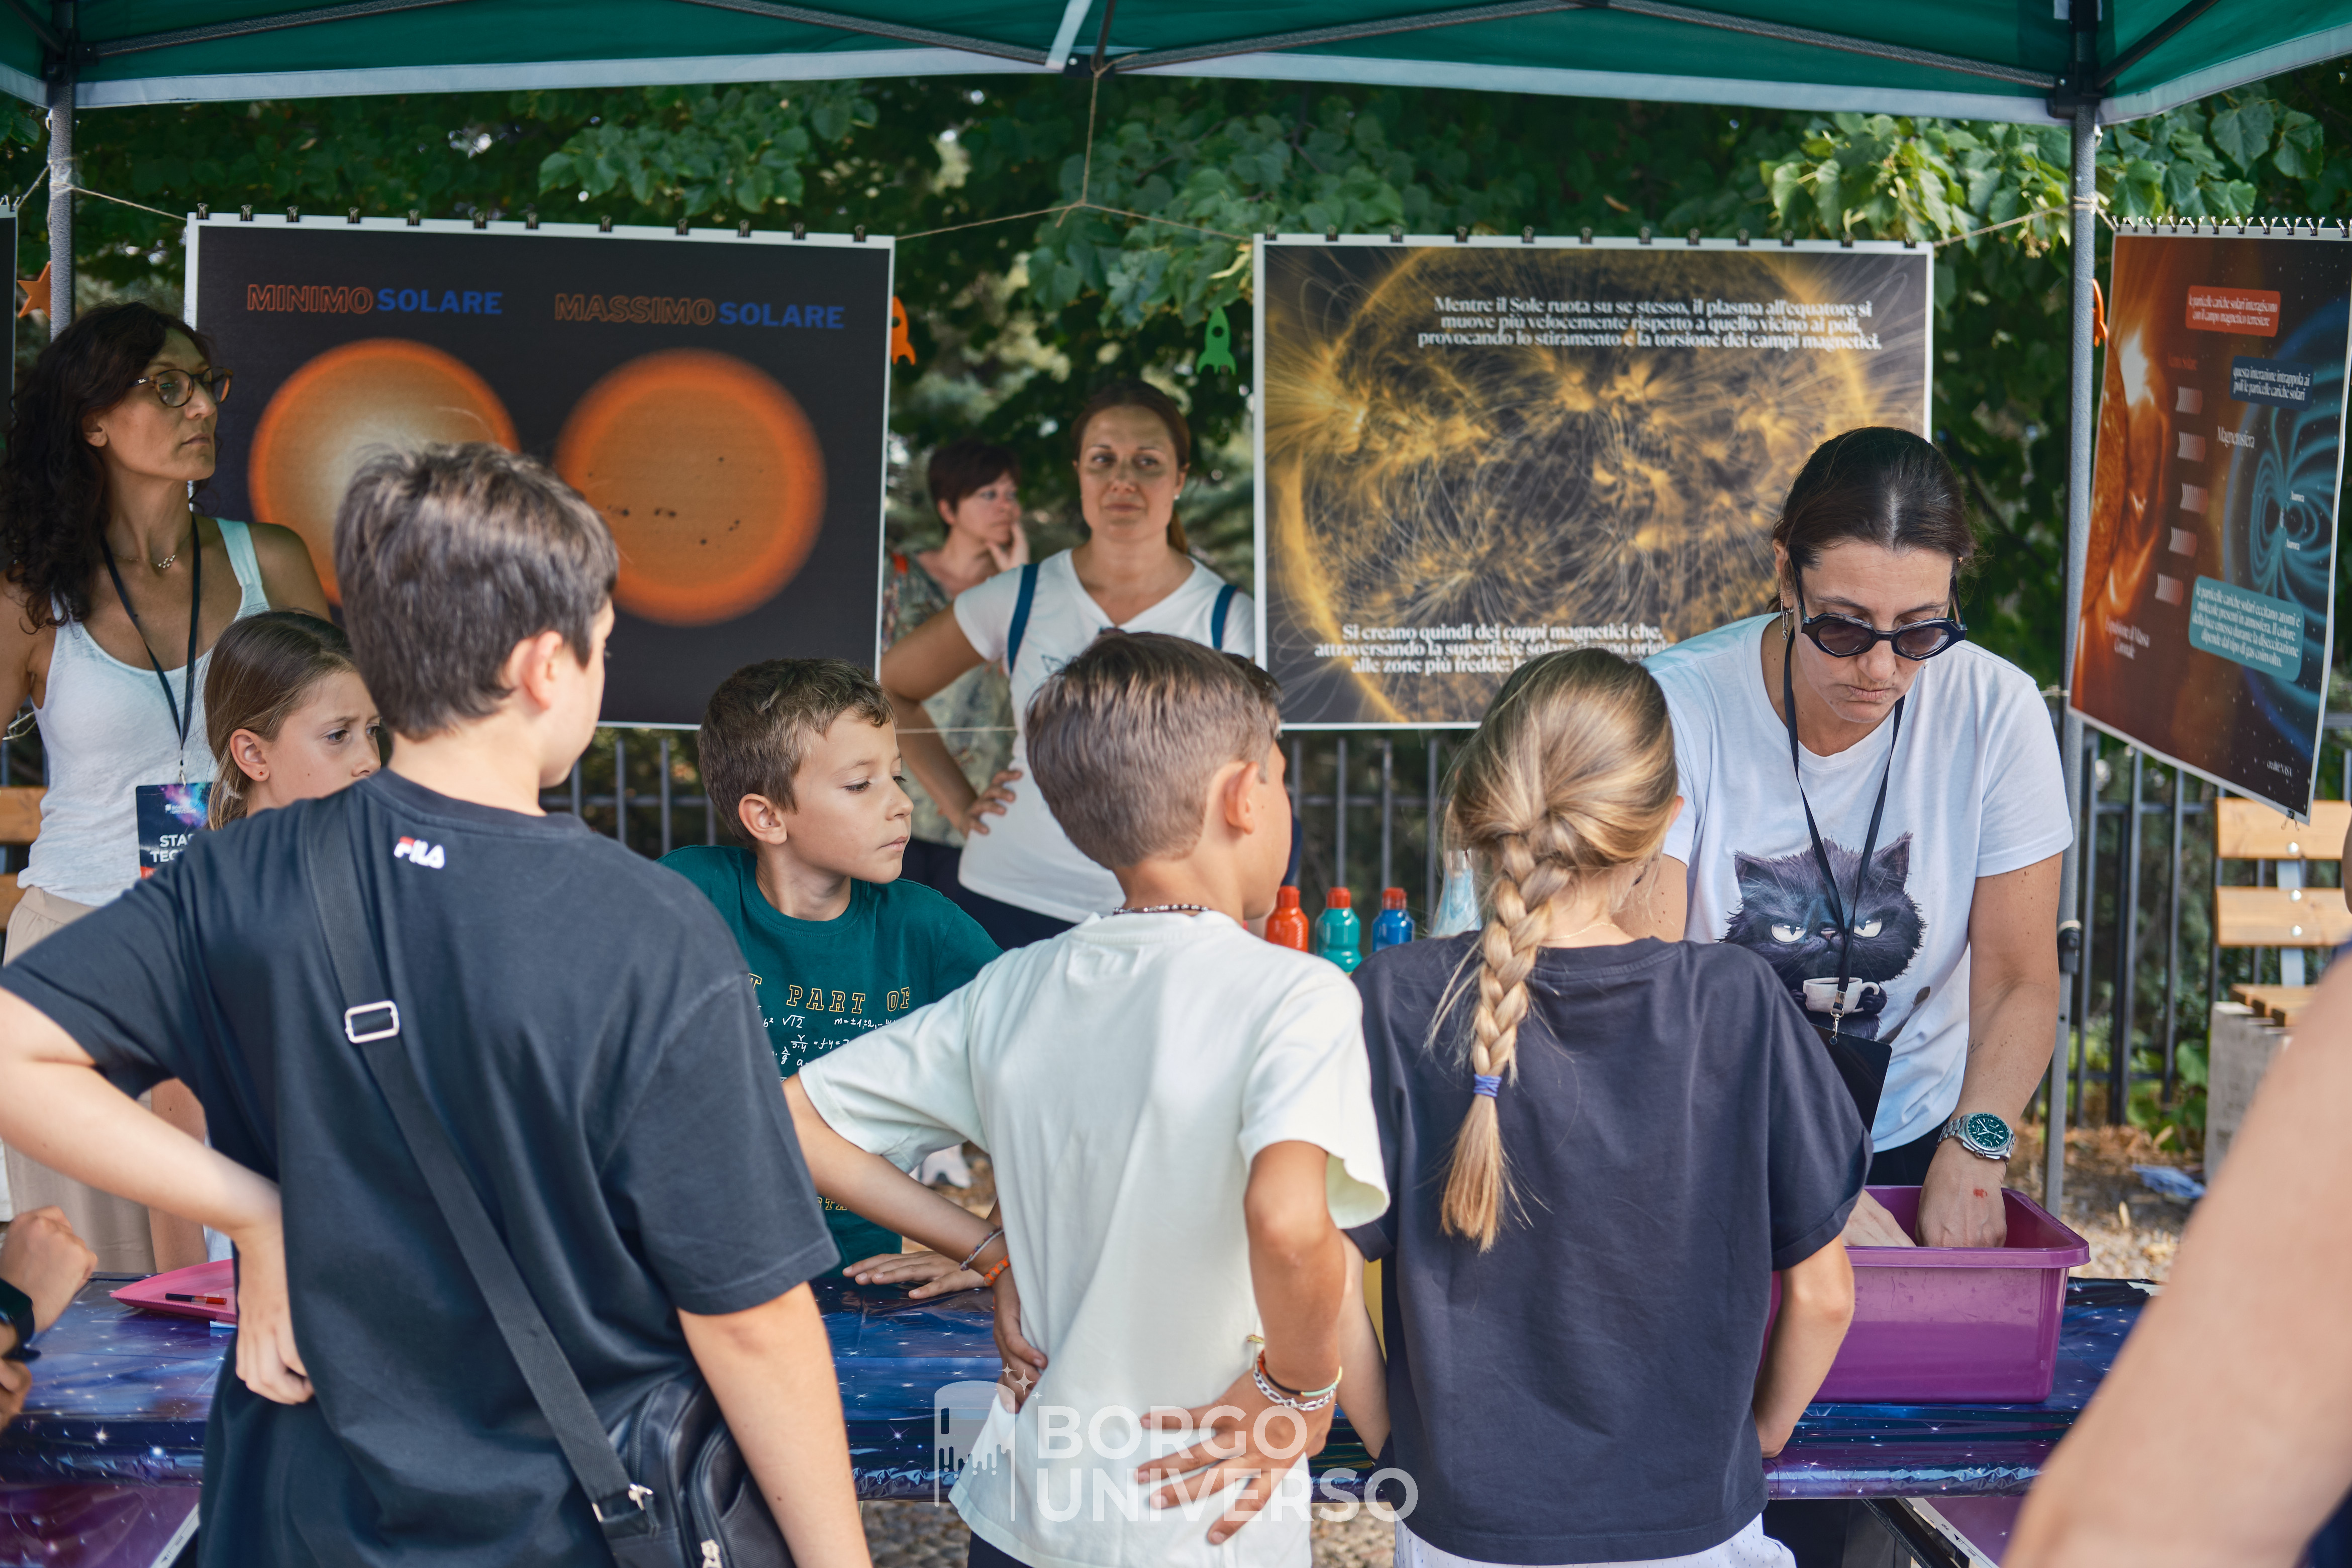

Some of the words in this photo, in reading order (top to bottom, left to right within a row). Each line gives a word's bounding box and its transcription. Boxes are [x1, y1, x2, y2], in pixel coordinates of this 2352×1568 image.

[247, 284, 373, 314] MINIMO
[377, 288, 502, 314] SOLARE
[1434, 297, 1493, 312] Mentre
[1496, 297, 1507, 312] il
[1510, 297, 1544, 313] Sole
[1547, 301, 1591, 314] ruota
[1593, 302, 1612, 314] su
[1615, 302, 1633, 314] se
[1636, 300, 1690, 315] stesso,
[1693, 299, 1703, 314] il
[1706, 299, 1763, 318] plasma
[1858, 300, 1873, 318] si
[554, 293, 716, 325] MASSIMO
[719, 302, 844, 328] SOLARE
[1441, 316, 1495, 329] muove
[1498, 314, 1525, 334] più
[1527, 314, 1629, 330] velocemente
[1631, 315, 1692, 333] rispetto
[1695, 320, 1705, 331] a
[1708, 316, 1758, 334] quello
[1760, 317, 1808, 332] vicino
[1810, 317, 1824, 332] ai
[1828, 317, 1862, 335] poli,
[1418, 331, 1514, 348] provocando
[1516, 331, 1532, 346] lo
[1535, 332, 1621, 346] stiramento
[1623, 334, 1634, 346] e
[1637, 332, 1651, 346] la
[1654, 332, 1720, 348] torsione
[1722, 332, 1747, 348] dei
[1750, 334, 1799, 351] campi
[1802, 333, 1882, 352] magnetici.
[1342, 623, 1359, 640] Si
[1361, 626, 1417, 640] creano
[1419, 623, 1473, 643] quindi
[1475, 623, 1501, 640] dei
[1503, 623, 1548, 643] cappi
[1550, 623, 1628, 643] magnetici
[1630, 623, 1664, 641] che,
[1314, 640, 1426, 657] attraversando
[1427, 639, 1443, 656] la
[1445, 640, 1525, 659] superficie
[1351, 657, 1380, 673] alle
[1383, 660, 1422, 673] zone
[1424, 657, 1452, 676] più
[1454, 656, 1510, 673] fredde:
[150, 849, 184, 863] TEC
[394, 836, 445, 869] FILA
[787, 985, 865, 1014] PART
[887, 987, 910, 1012] OF
